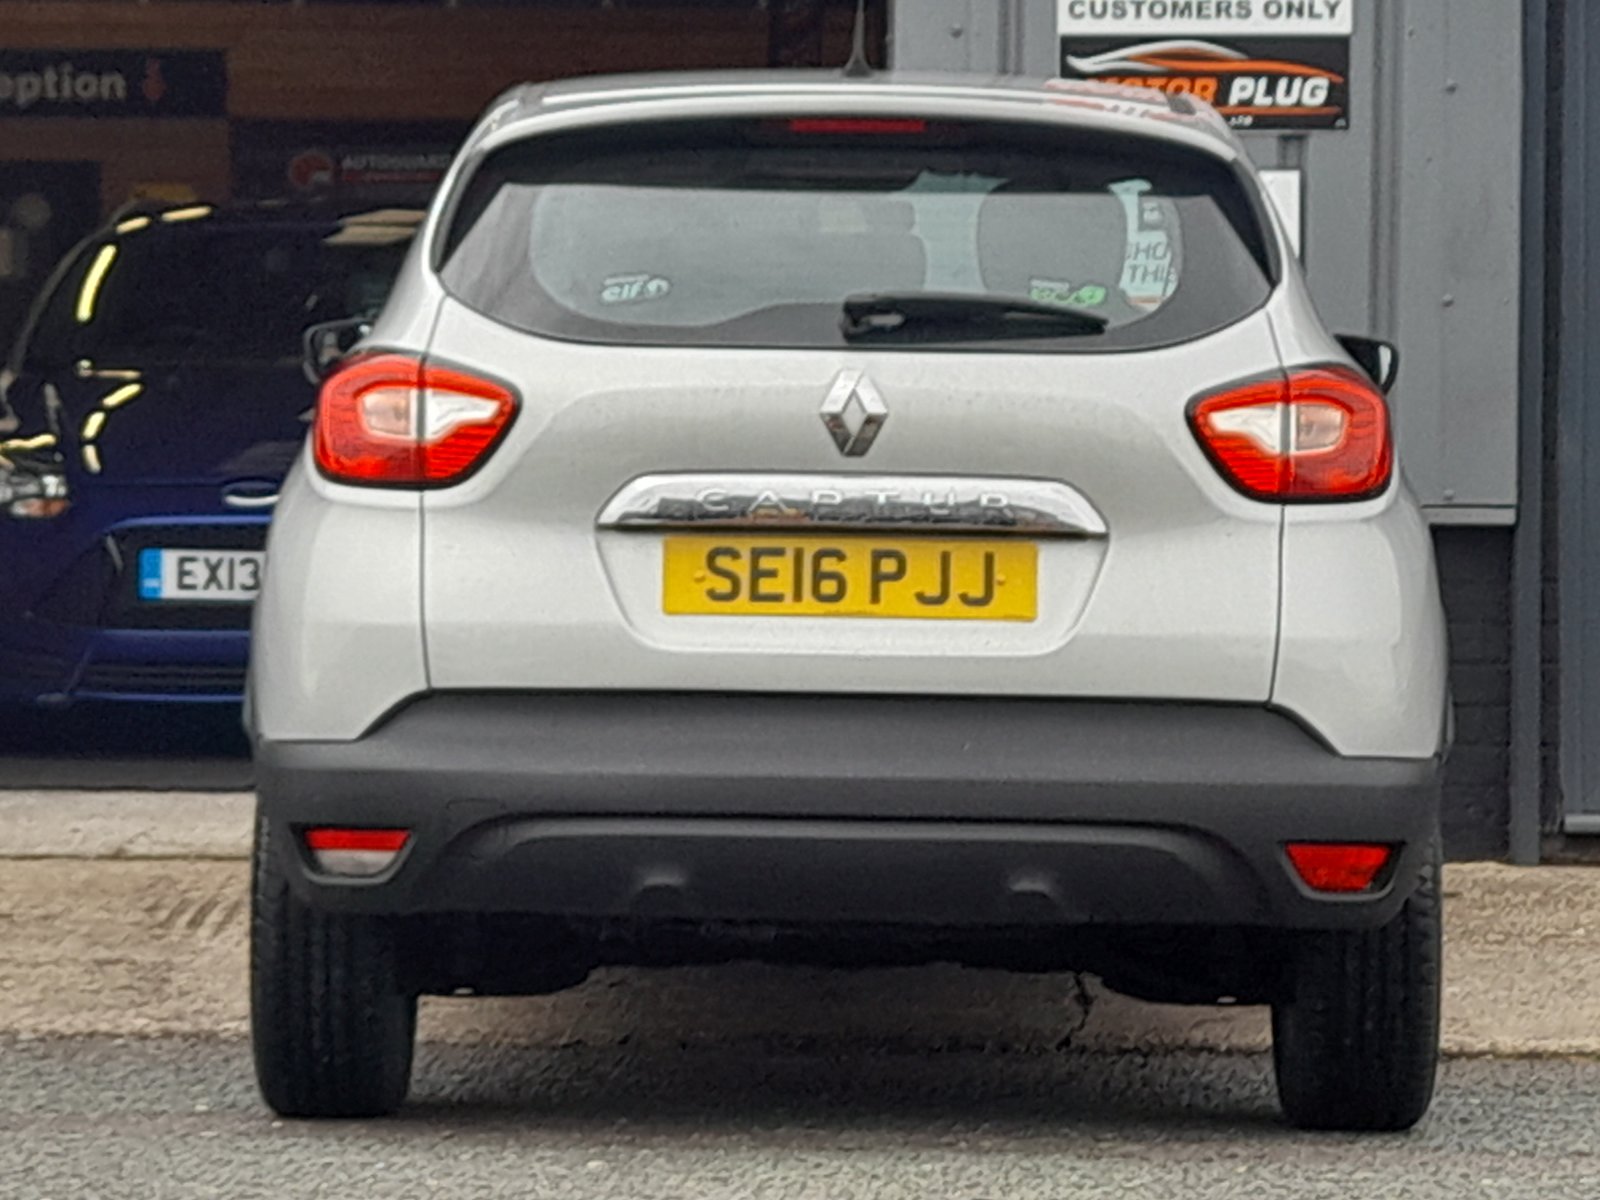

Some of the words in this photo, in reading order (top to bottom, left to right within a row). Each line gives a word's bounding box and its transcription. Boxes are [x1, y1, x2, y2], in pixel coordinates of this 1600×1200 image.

[1069, 0, 1253, 19] CUSTOMERS
[1263, 0, 1343, 18] ONLY
[1227, 77, 1329, 107] PLUG
[696, 488, 1011, 514] CAPTUR
[177, 556, 261, 591] EX13
[705, 546, 848, 603] SE16
[870, 549, 997, 606] PJJ
